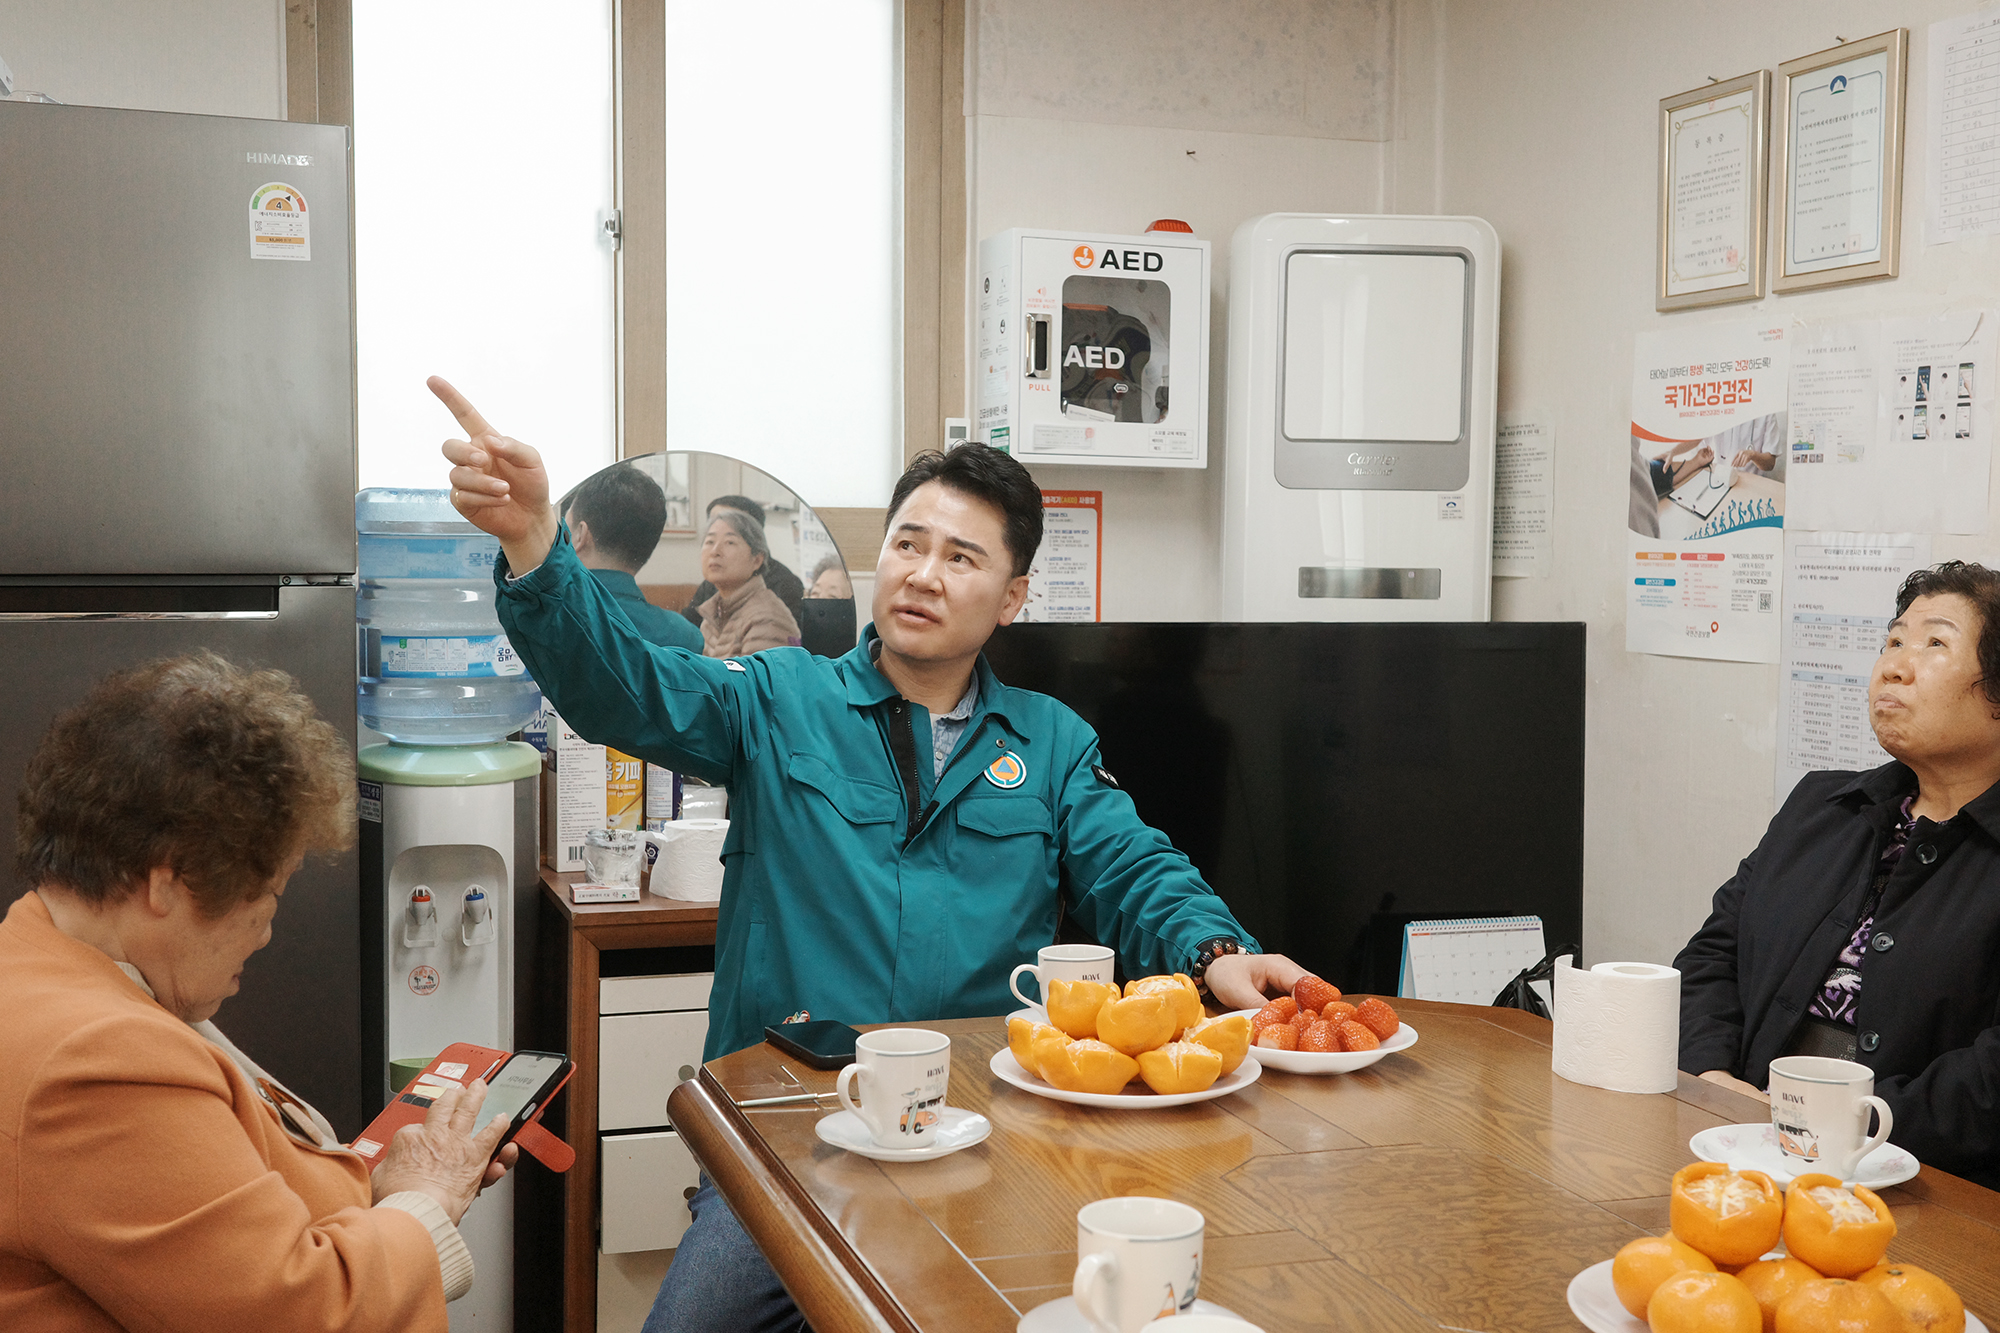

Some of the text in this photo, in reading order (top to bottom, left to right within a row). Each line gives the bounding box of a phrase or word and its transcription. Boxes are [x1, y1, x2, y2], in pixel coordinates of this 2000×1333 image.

[1100, 249, 1163, 272] AED
[1063, 345, 1126, 370] AED
[1650, 368, 1669, 380] 태어날
[1669, 366, 1689, 378] 때부터
[1719, 361, 1733, 373] 모두
[1734, 357, 1772, 372] 건강하도록!
[1028, 383, 1051, 392] PULL
[1664, 378, 1753, 408] 국가건강검진
[1347, 452, 1400, 466] Carrier
[1782, 1092, 1805, 1105] HAVE
